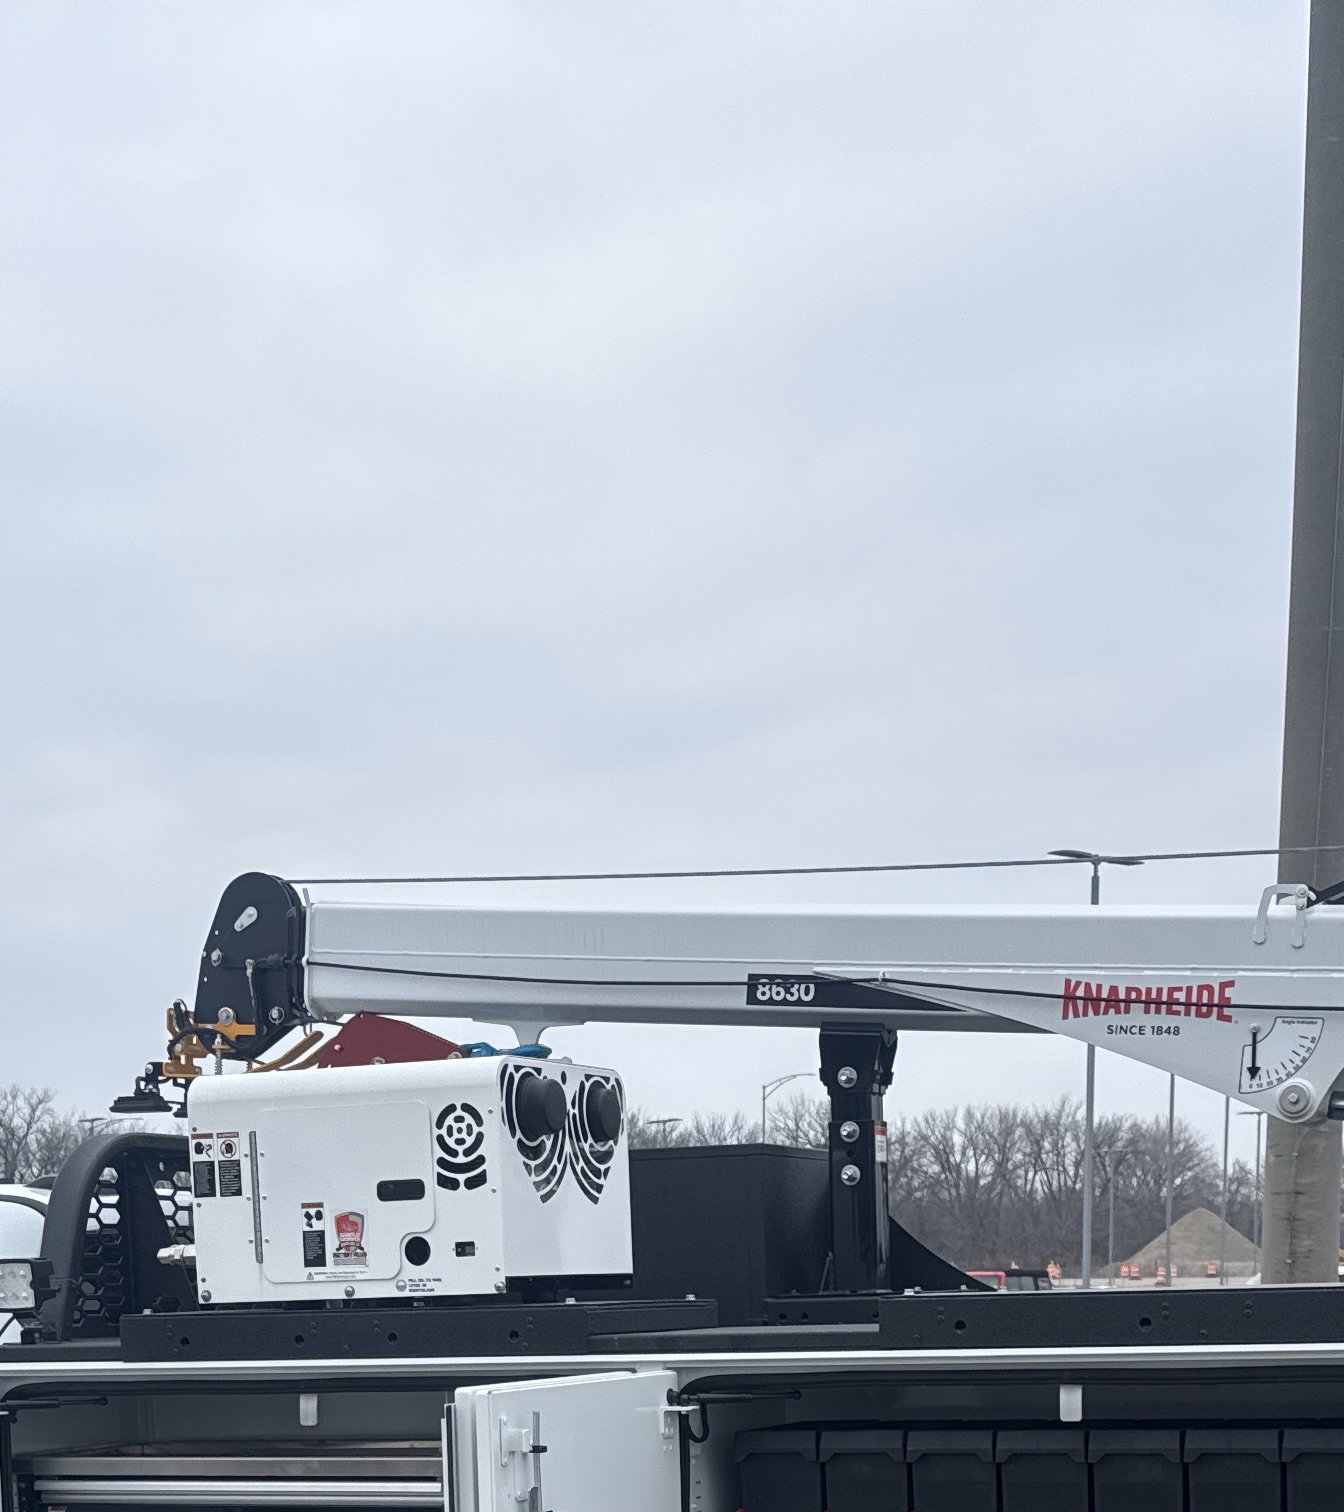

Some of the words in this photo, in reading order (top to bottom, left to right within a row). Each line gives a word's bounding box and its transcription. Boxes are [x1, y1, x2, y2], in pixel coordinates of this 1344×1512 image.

[756, 978, 816, 1002] 8630
[1061, 977, 1236, 1023] KNAPHEIDE
[1106, 1024, 1146, 1036] SINCE
[1150, 1025, 1181, 1037] 1848
